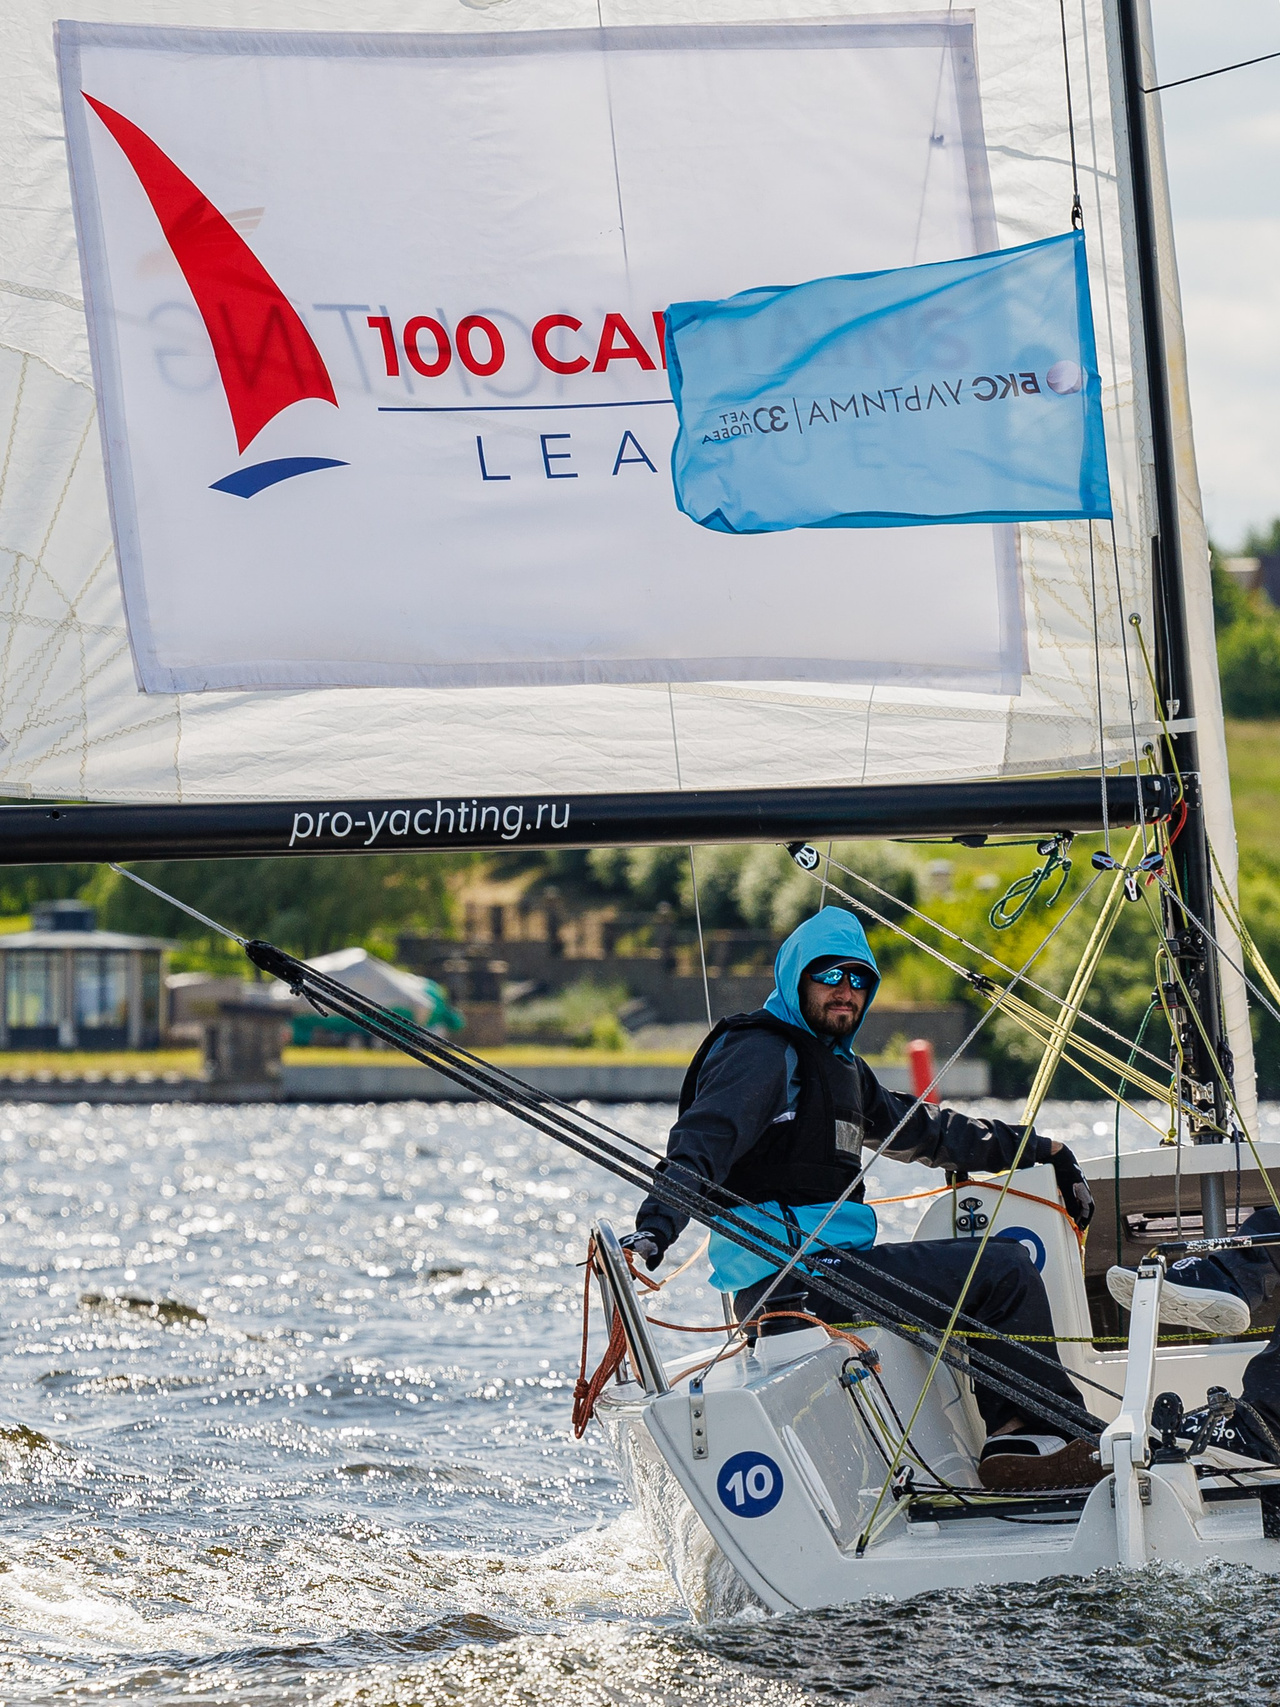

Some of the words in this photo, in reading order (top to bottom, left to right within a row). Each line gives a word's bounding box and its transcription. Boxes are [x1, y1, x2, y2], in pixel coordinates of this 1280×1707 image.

[366, 314, 506, 378] 100
[288, 799, 571, 847] pro-yachting.ru
[725, 1464, 774, 1507] 10
